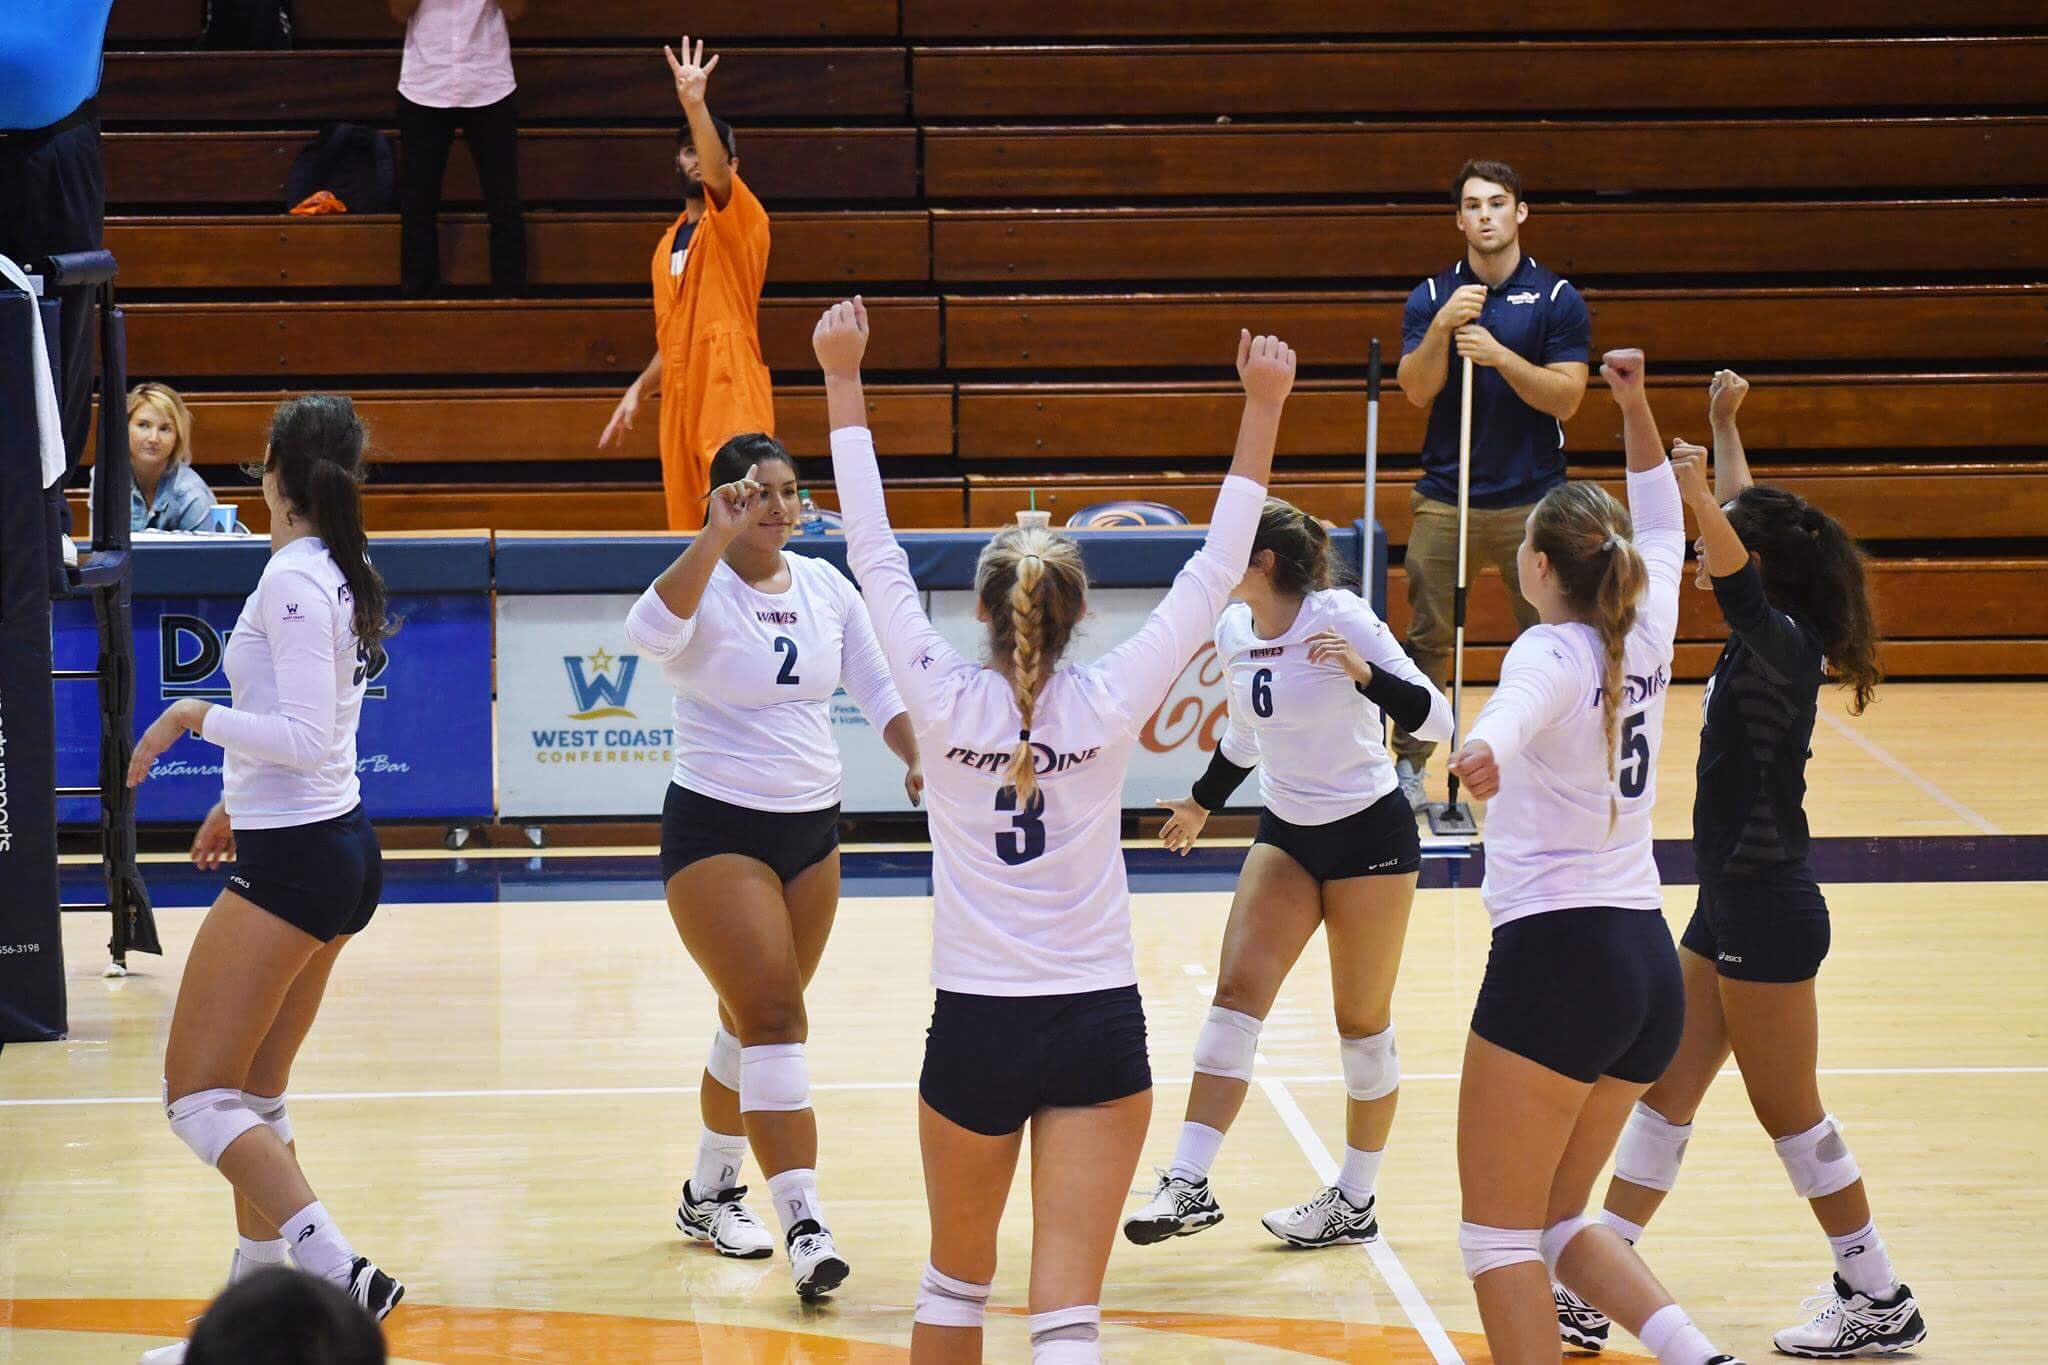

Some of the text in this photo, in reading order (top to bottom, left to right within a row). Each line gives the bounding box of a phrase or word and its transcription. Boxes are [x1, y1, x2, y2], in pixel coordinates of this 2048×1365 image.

[756, 611, 798, 625] WAVES
[563, 655, 640, 712] W
[774, 636, 800, 685] 2
[1252, 668, 1274, 718] 6
[371, 754, 411, 773] Bar
[532, 730, 674, 748] WEST COAST
[537, 751, 672, 764] CONFERENCE
[1619, 711, 1650, 798] 5
[995, 784, 1046, 866] 3
